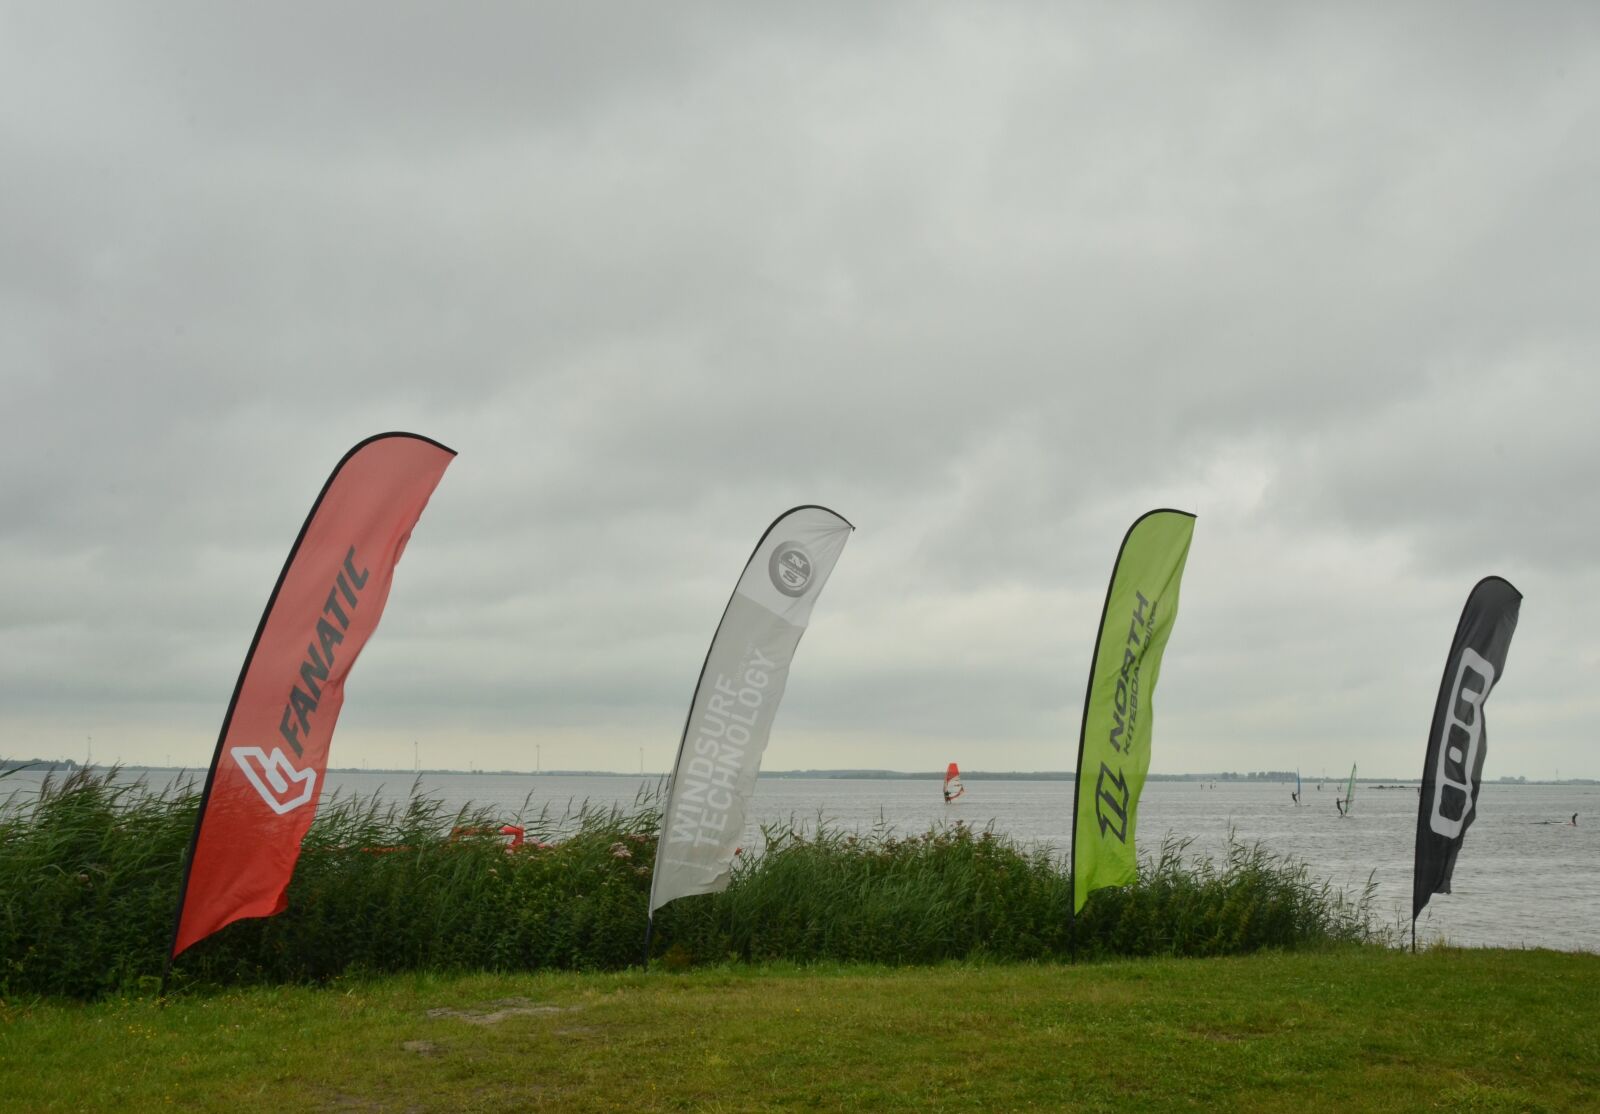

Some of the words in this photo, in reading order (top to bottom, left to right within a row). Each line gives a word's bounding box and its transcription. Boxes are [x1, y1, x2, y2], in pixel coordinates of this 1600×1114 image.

[279, 544, 370, 760] FANATIC
[1109, 590, 1149, 753] NORTH
[669, 673, 738, 845] WINDSURF
[692, 647, 776, 849] TECHNOLOGY
